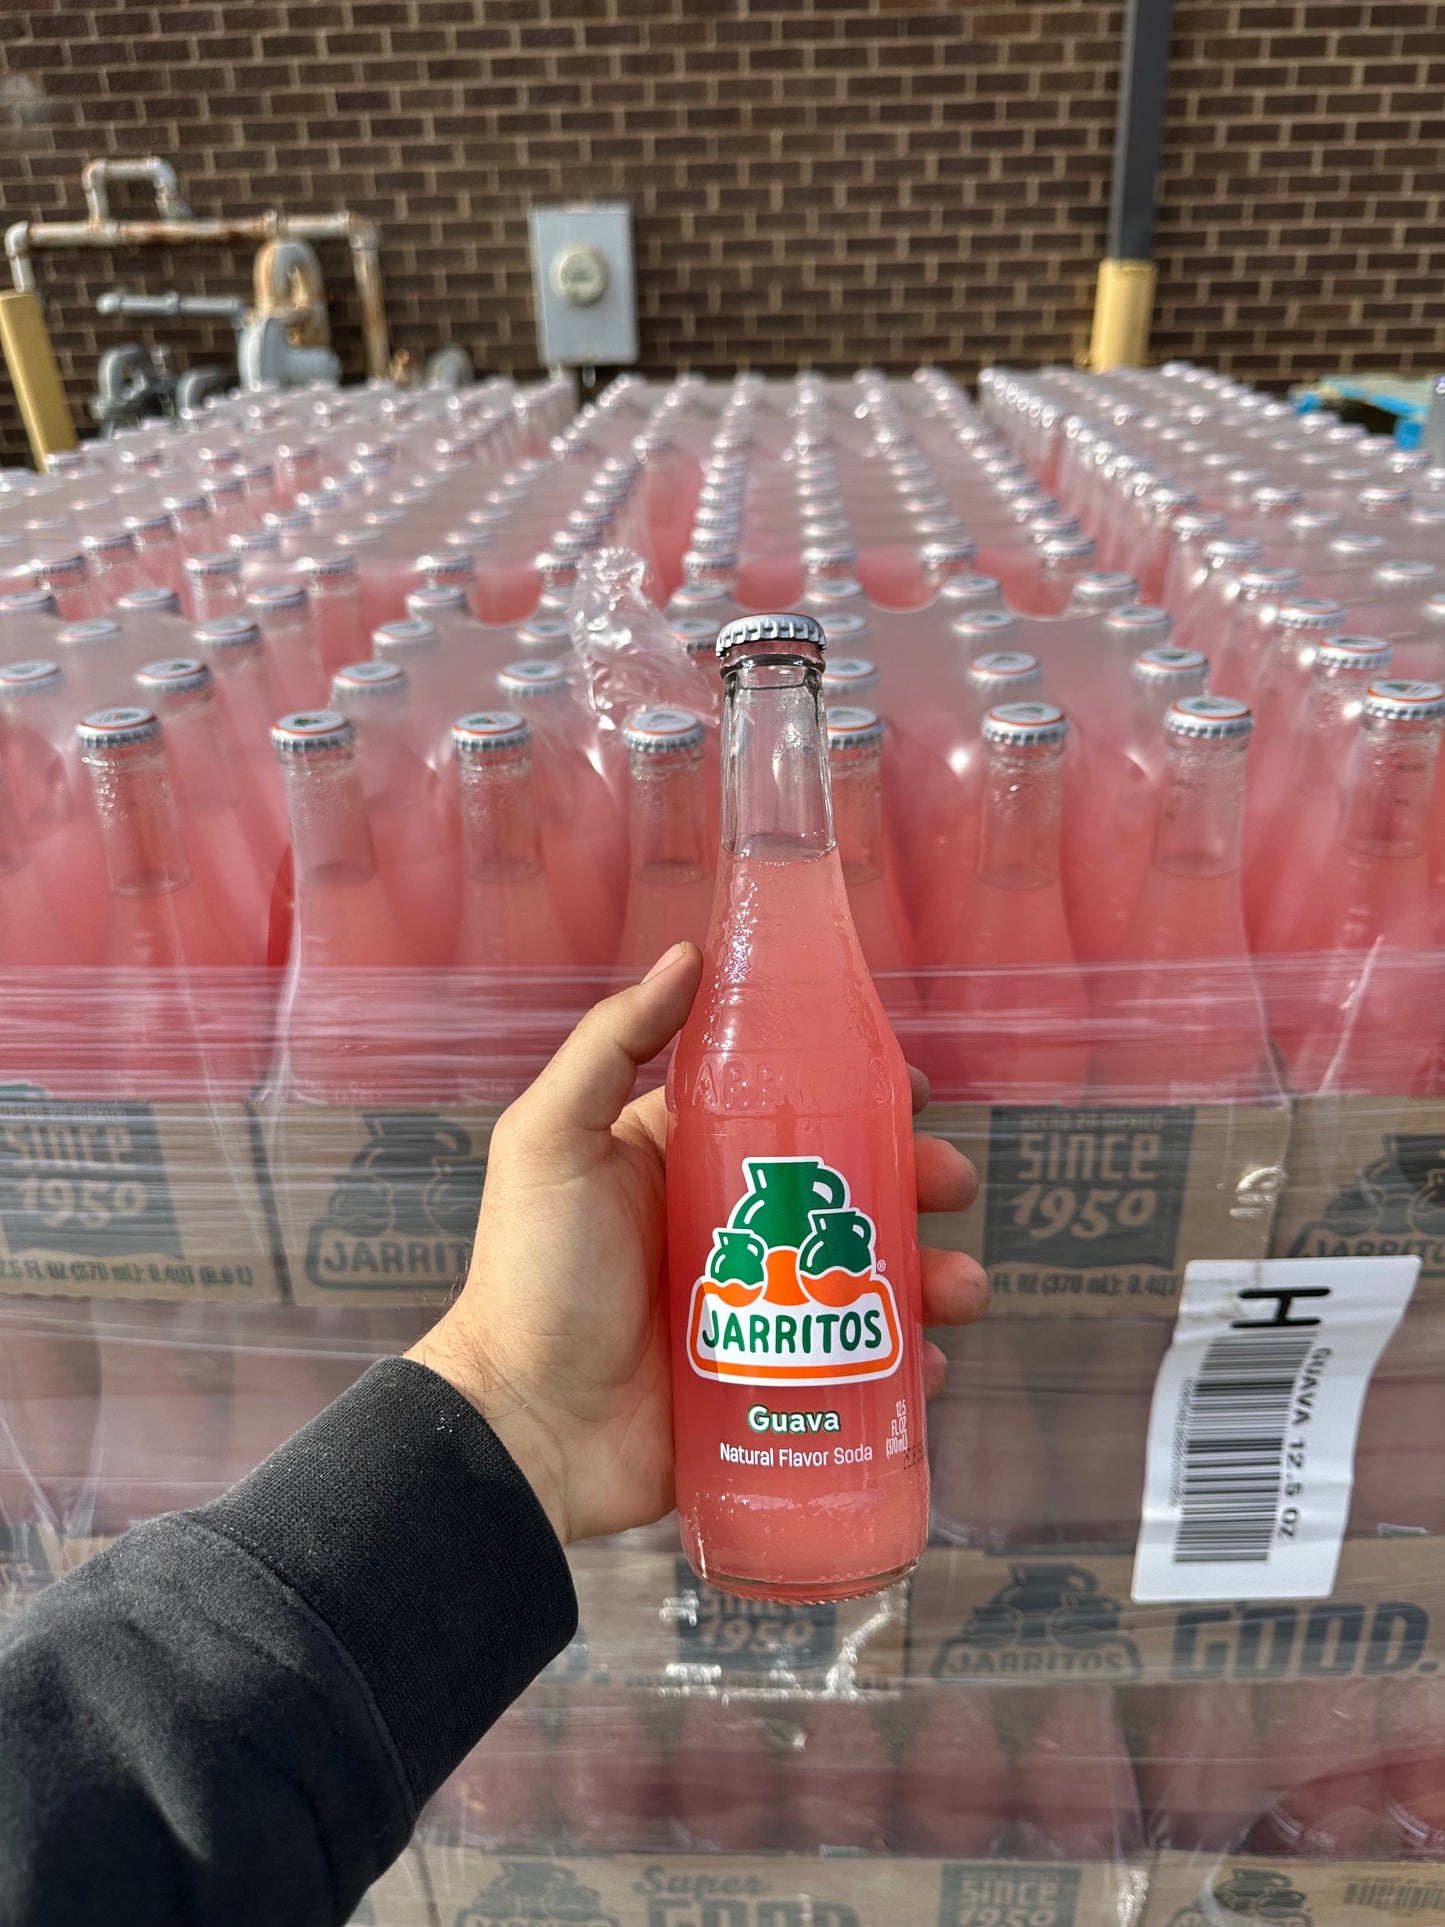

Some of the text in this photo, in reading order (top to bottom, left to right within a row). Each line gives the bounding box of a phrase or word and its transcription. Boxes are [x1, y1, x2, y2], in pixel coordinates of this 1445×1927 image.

[16, 1173, 149, 1229] 1950
[1011, 1183, 1158, 1240] 1950
[1230, 1286, 1331, 1329] H
[702, 1310, 882, 1354] JARRITOS
[1293, 1346, 1333, 1426] GUAVA
[747, 1404, 841, 1434] Guava
[720, 1442, 873, 1468] Natural Flavor Soda
[1284, 1435, 1307, 1498] 12.5
[950, 1651, 1123, 1673] JARRITOS
[632, 1865, 770, 1901] Super
